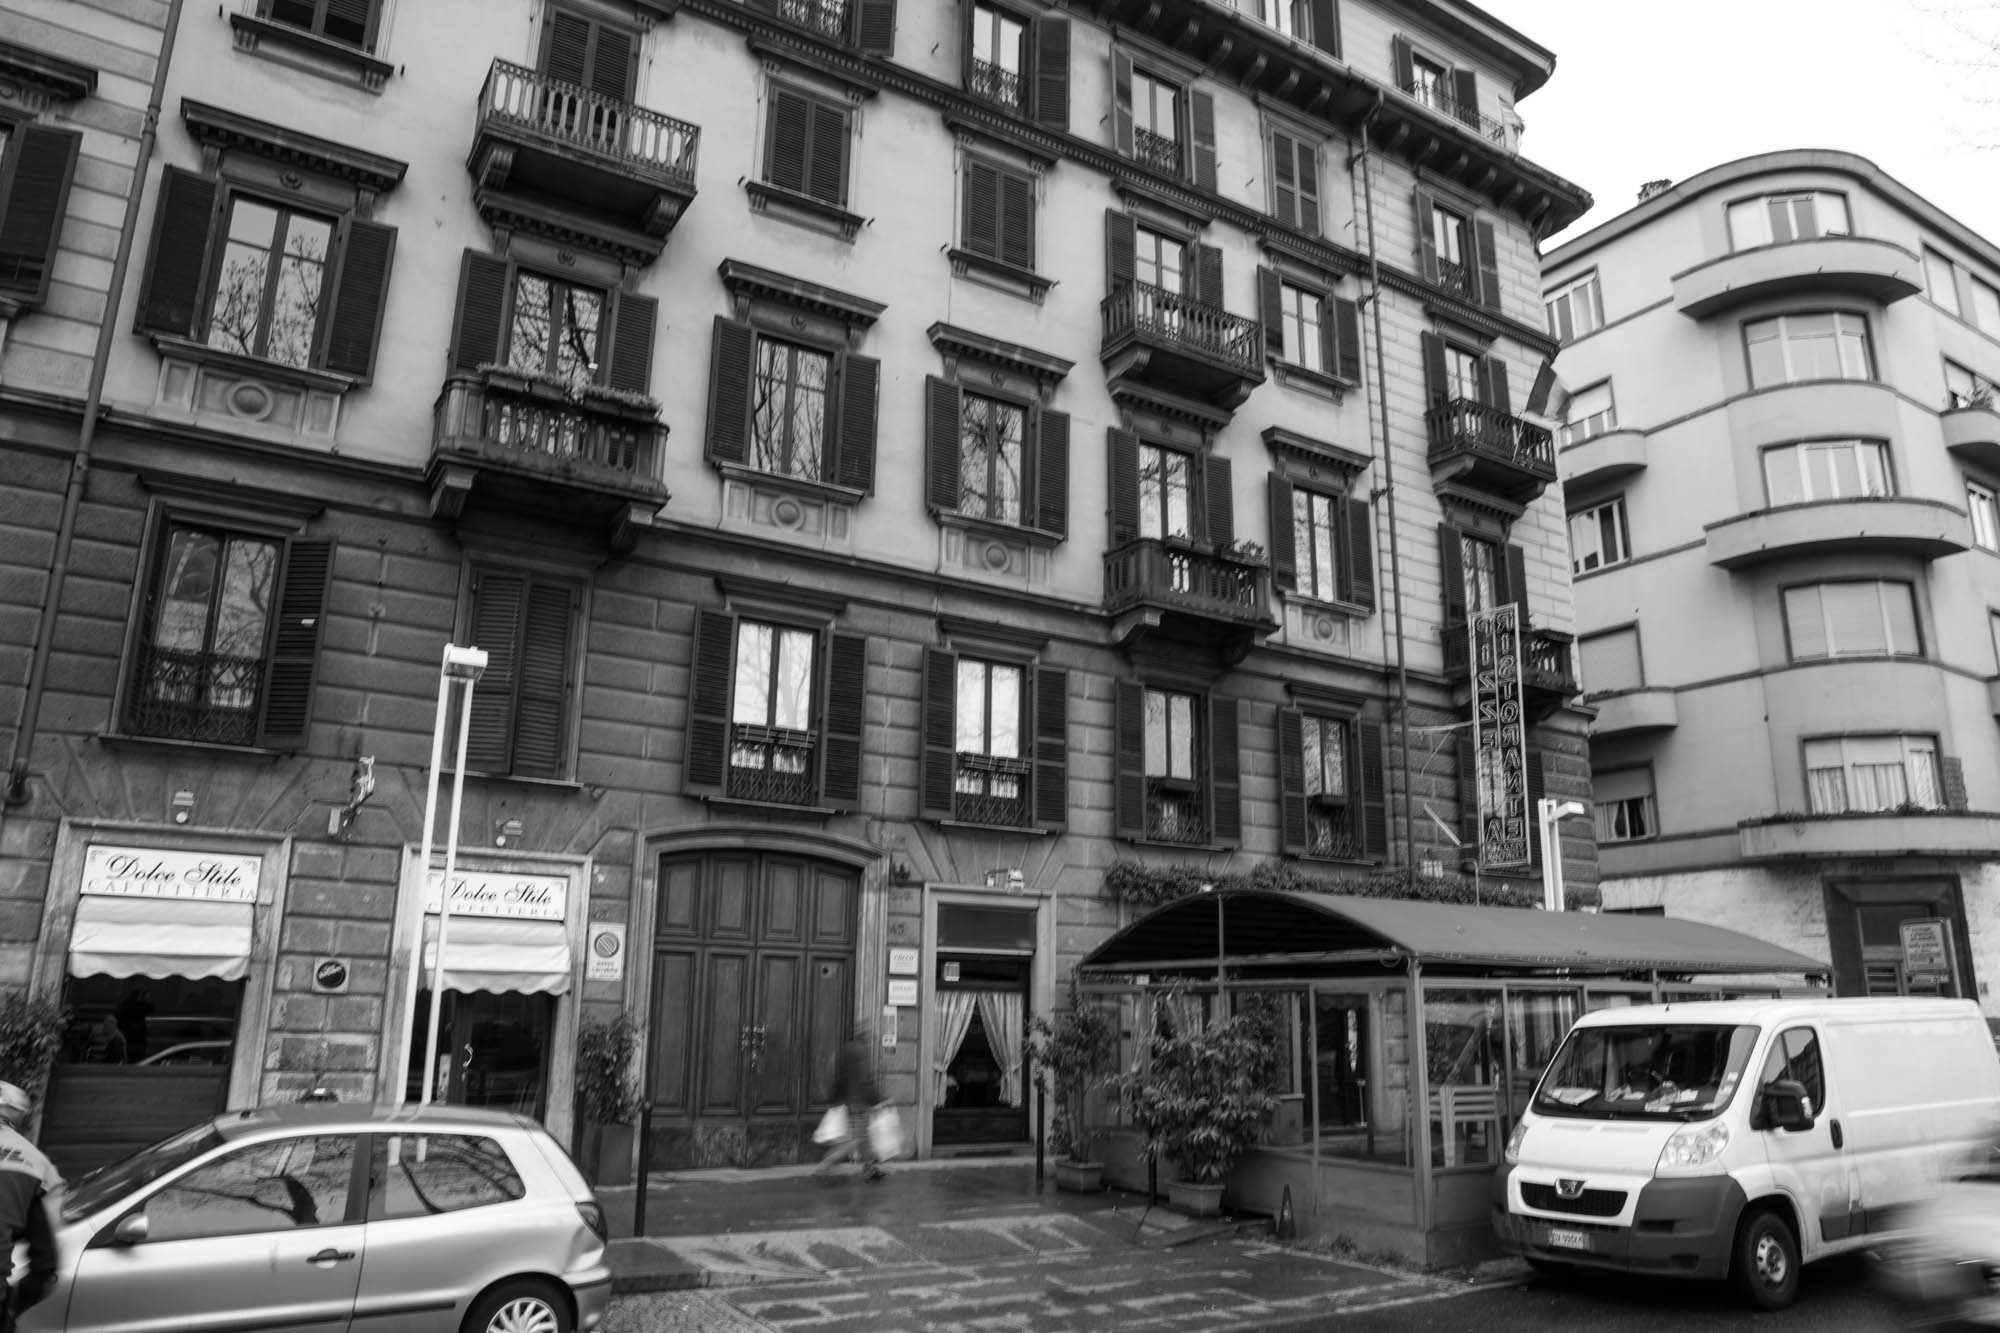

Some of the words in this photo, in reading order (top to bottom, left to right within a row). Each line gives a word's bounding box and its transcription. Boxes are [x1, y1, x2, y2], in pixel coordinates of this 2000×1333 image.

[105, 853, 175, 882] Dolce
[184, 859, 241, 886] Stile
[504, 880, 551, 905] Stile
